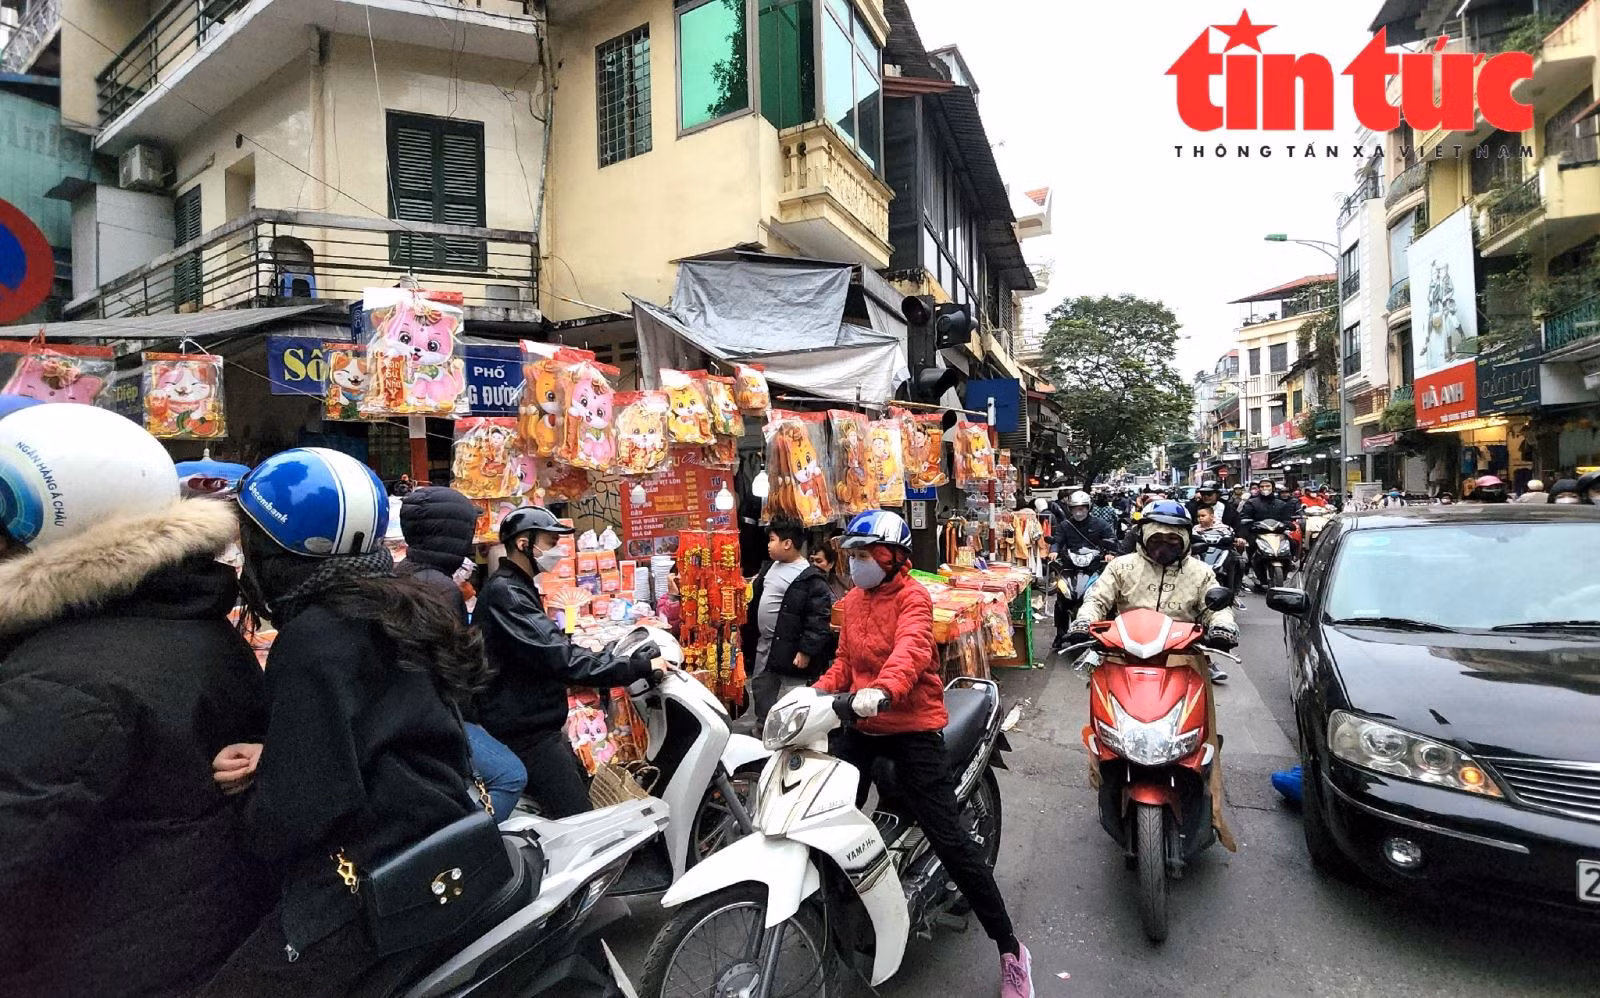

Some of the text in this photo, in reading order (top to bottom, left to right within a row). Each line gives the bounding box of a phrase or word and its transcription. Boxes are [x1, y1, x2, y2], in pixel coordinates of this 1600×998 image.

[473, 365, 505, 379] PHỐ
[16, 441, 41, 464] NGÂN
[36, 462, 58, 491] HÀNG
[52, 500, 67, 528] CHÂU
[249, 482, 288, 524] Sacombank
